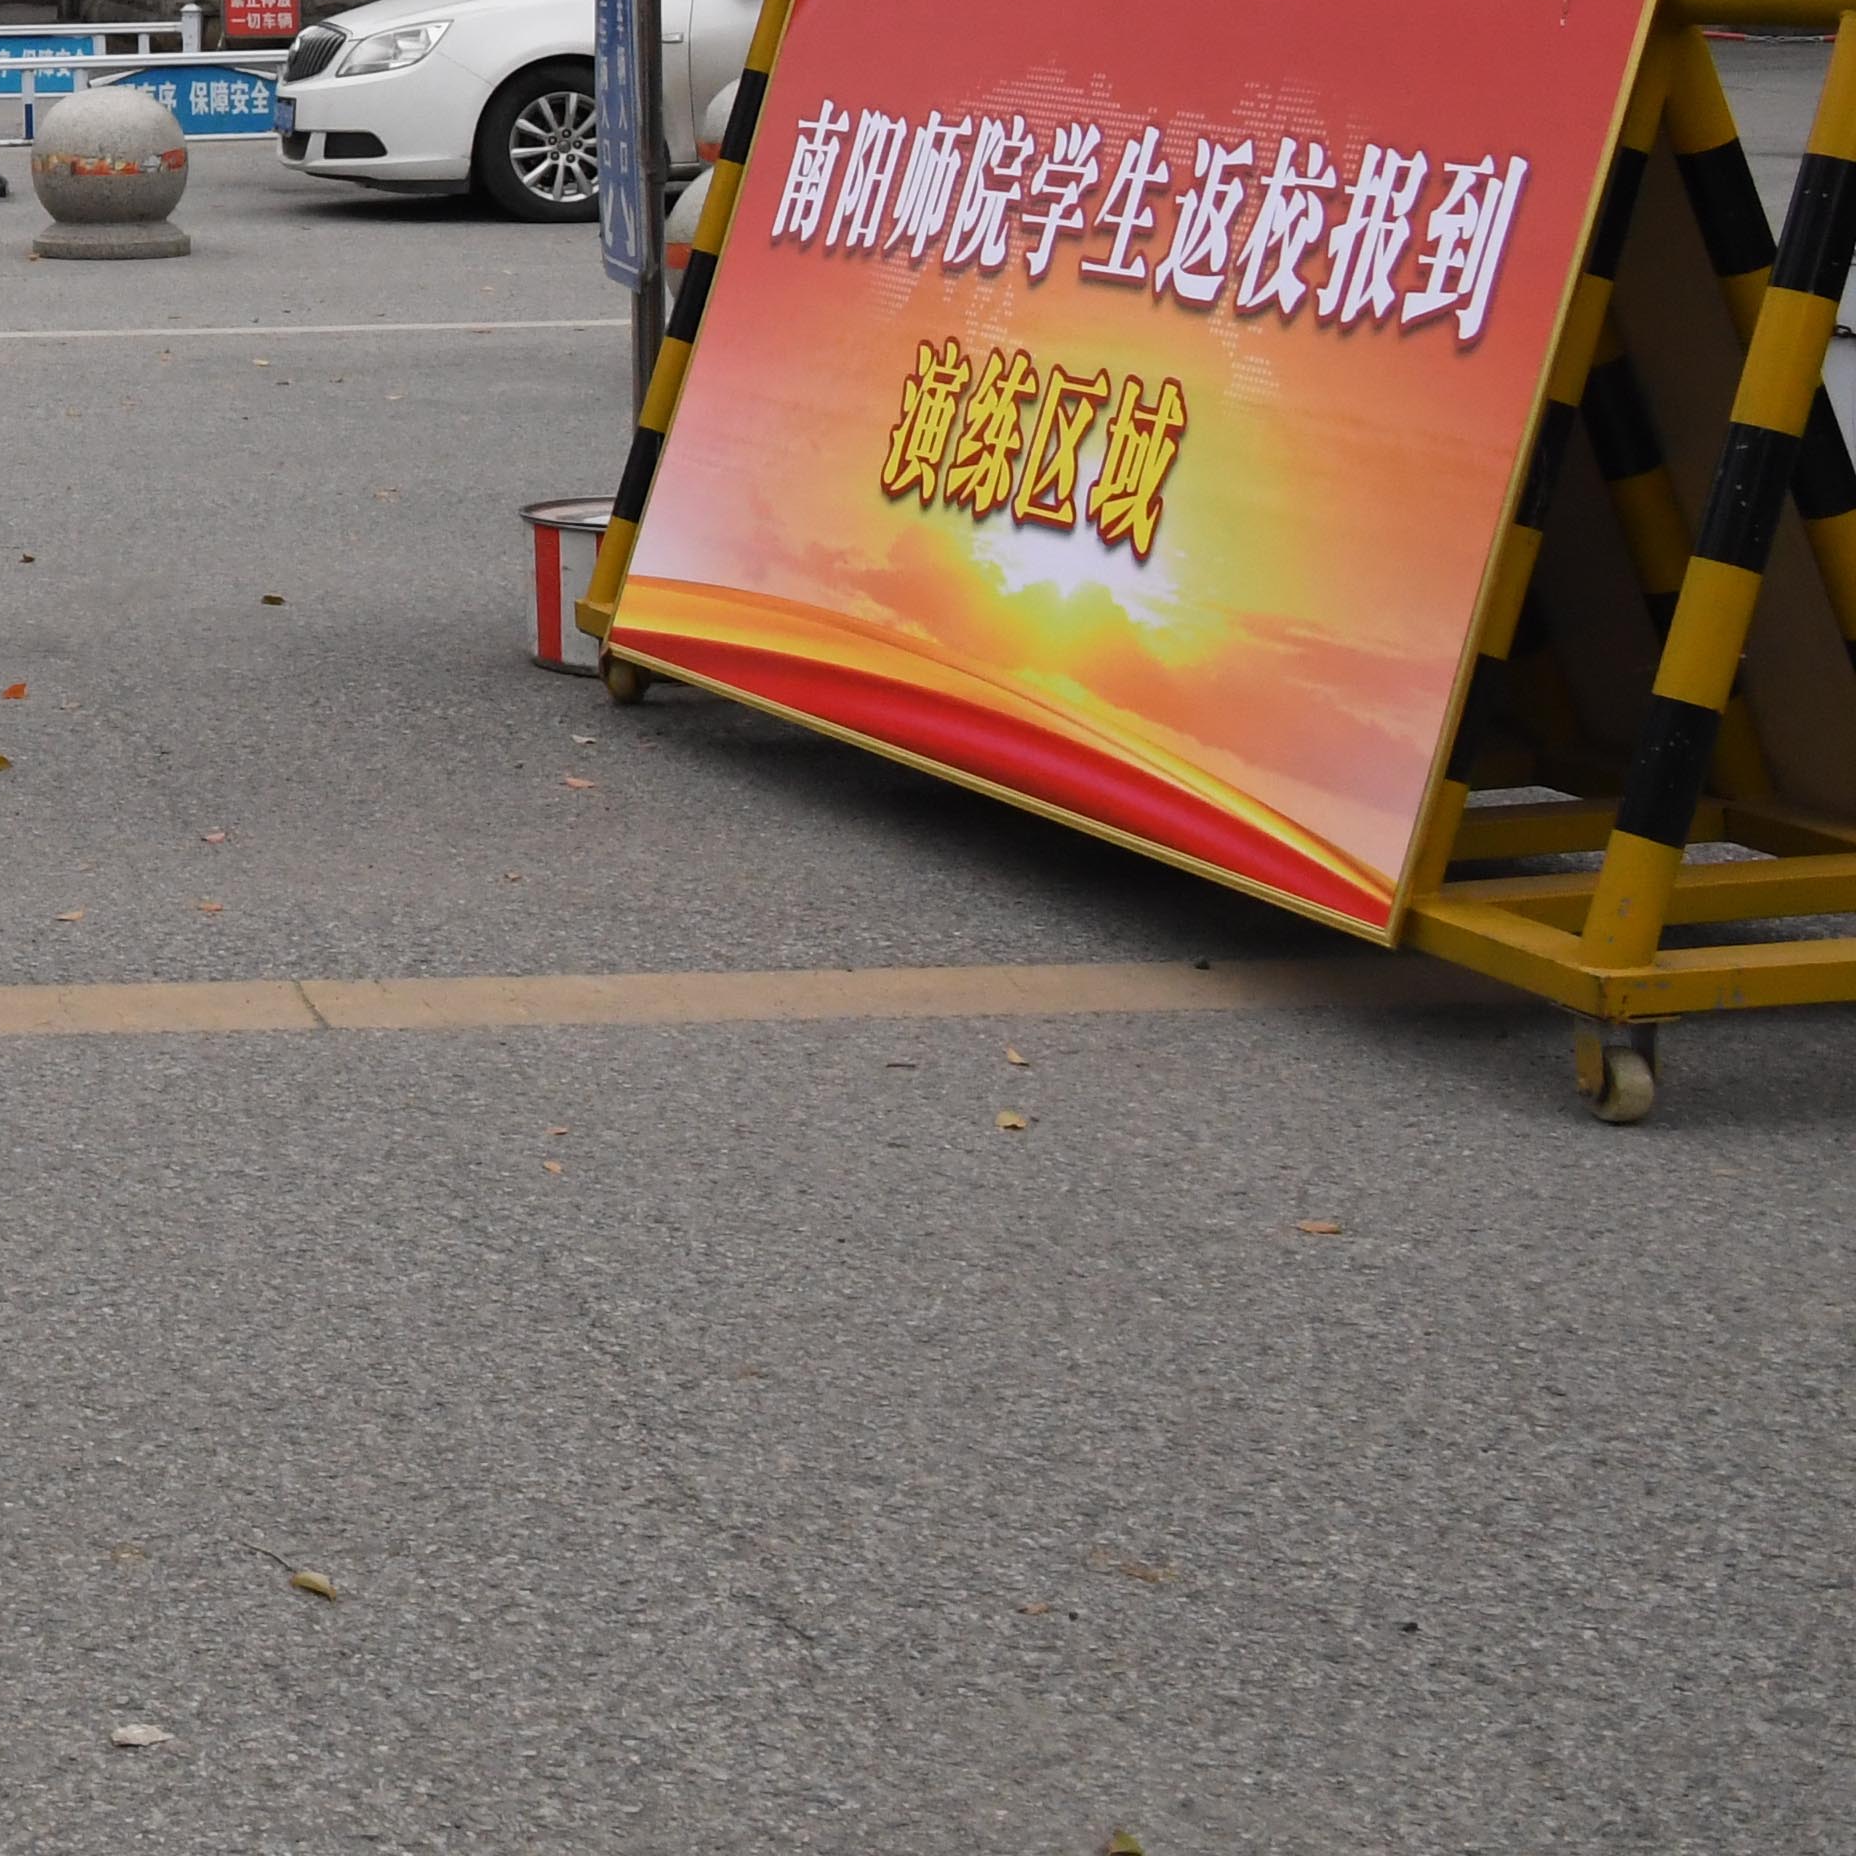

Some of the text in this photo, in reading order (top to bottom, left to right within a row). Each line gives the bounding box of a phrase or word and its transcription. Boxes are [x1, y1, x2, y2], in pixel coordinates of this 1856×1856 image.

[230, 12, 293, 30] 一切车辆
[189, 79, 270, 116] 保障安全
[770, 98, 1528, 341] 南阳师院学生返校报到
[883, 338, 1184, 559] 演练区域
